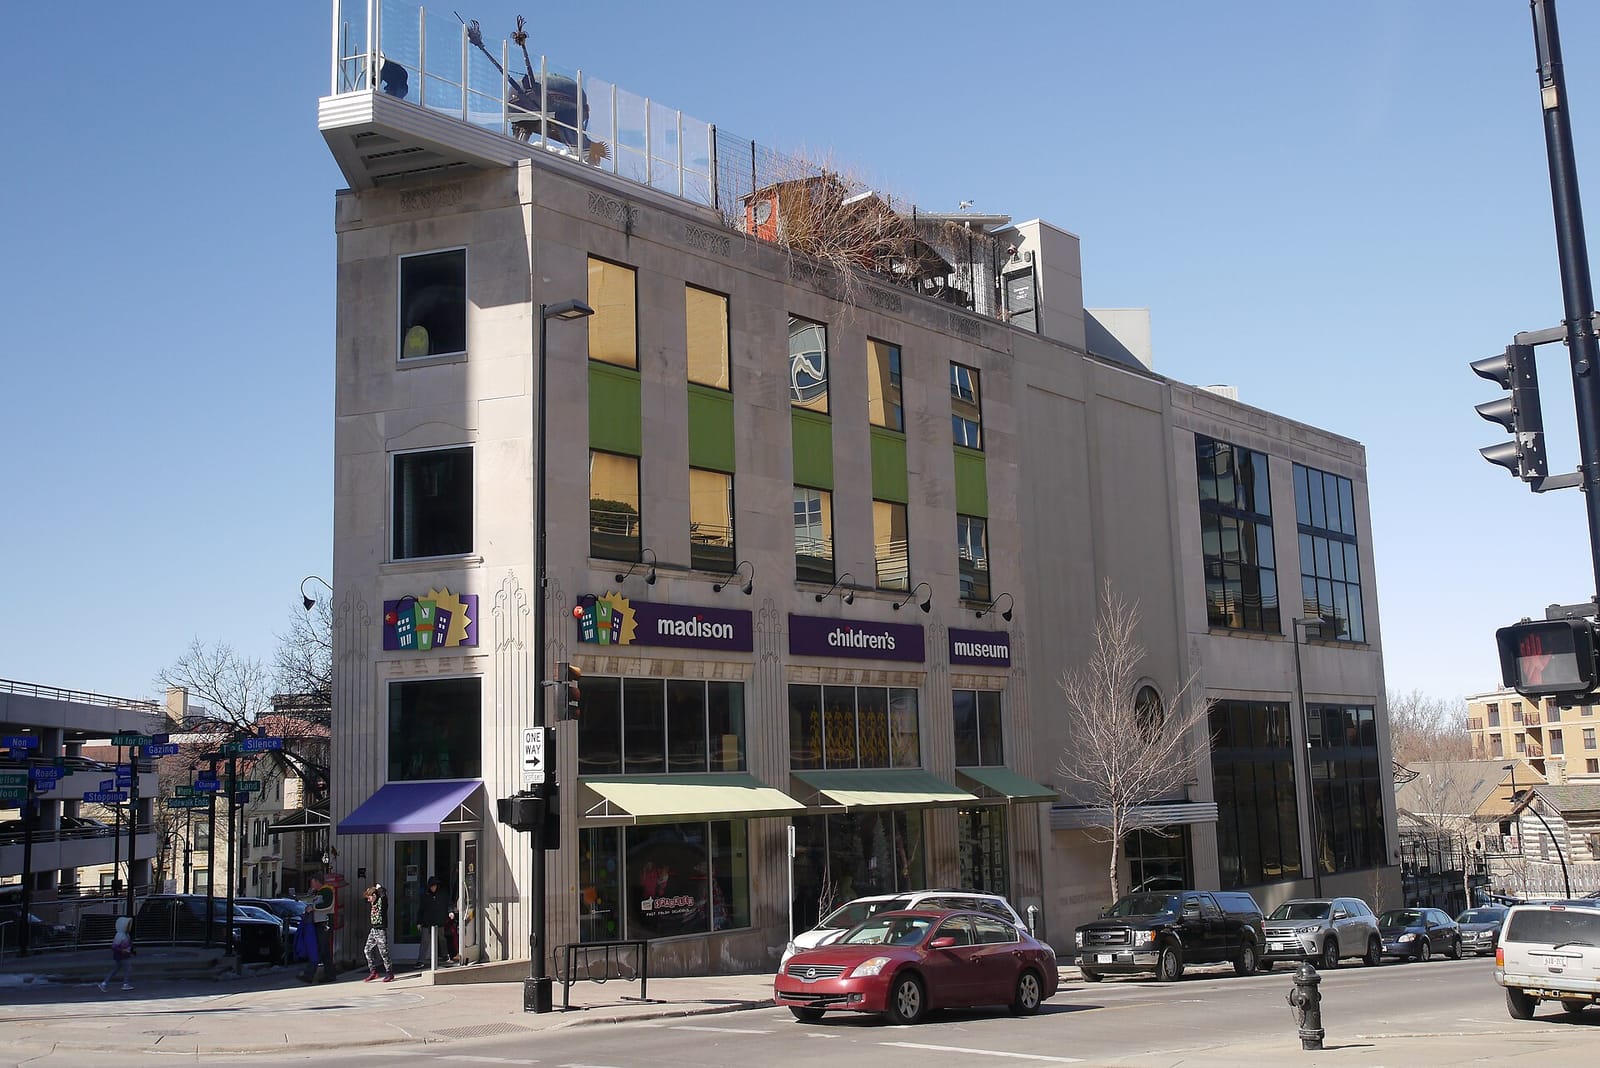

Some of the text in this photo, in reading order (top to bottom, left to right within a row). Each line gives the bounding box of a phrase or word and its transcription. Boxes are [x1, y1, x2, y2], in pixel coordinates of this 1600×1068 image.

[658, 613, 734, 639] madison
[827, 626, 896, 650] children's
[954, 641, 1009, 659] museum
[113, 736, 123, 745] All
[125, 736, 137, 745] for
[526, 732, 541, 743] ONE
[149, 745, 174, 755] Gazing
[247, 740, 278, 749] Silence
[526, 744, 541, 754] WAY
[35, 768, 58, 779] Roads
[240, 781, 258, 791] Land
[88, 792, 124, 803] Stopping
